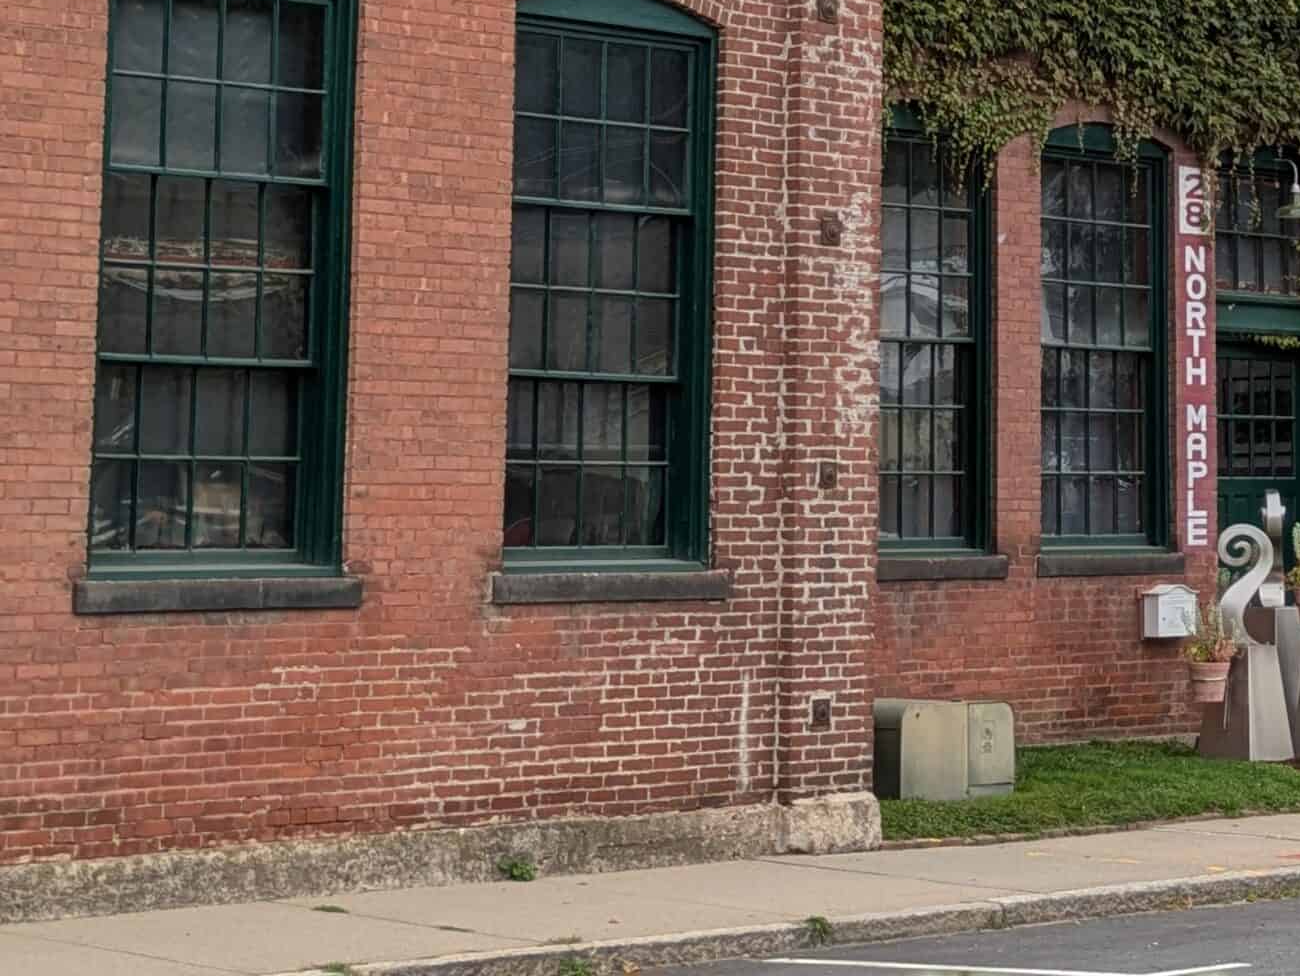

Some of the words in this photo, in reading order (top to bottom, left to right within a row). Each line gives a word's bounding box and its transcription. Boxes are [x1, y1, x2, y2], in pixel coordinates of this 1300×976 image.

[1185, 174, 1205, 227] 28
[1185, 245, 1207, 385] NORTH
[1186, 404, 1208, 546] MAPLE
